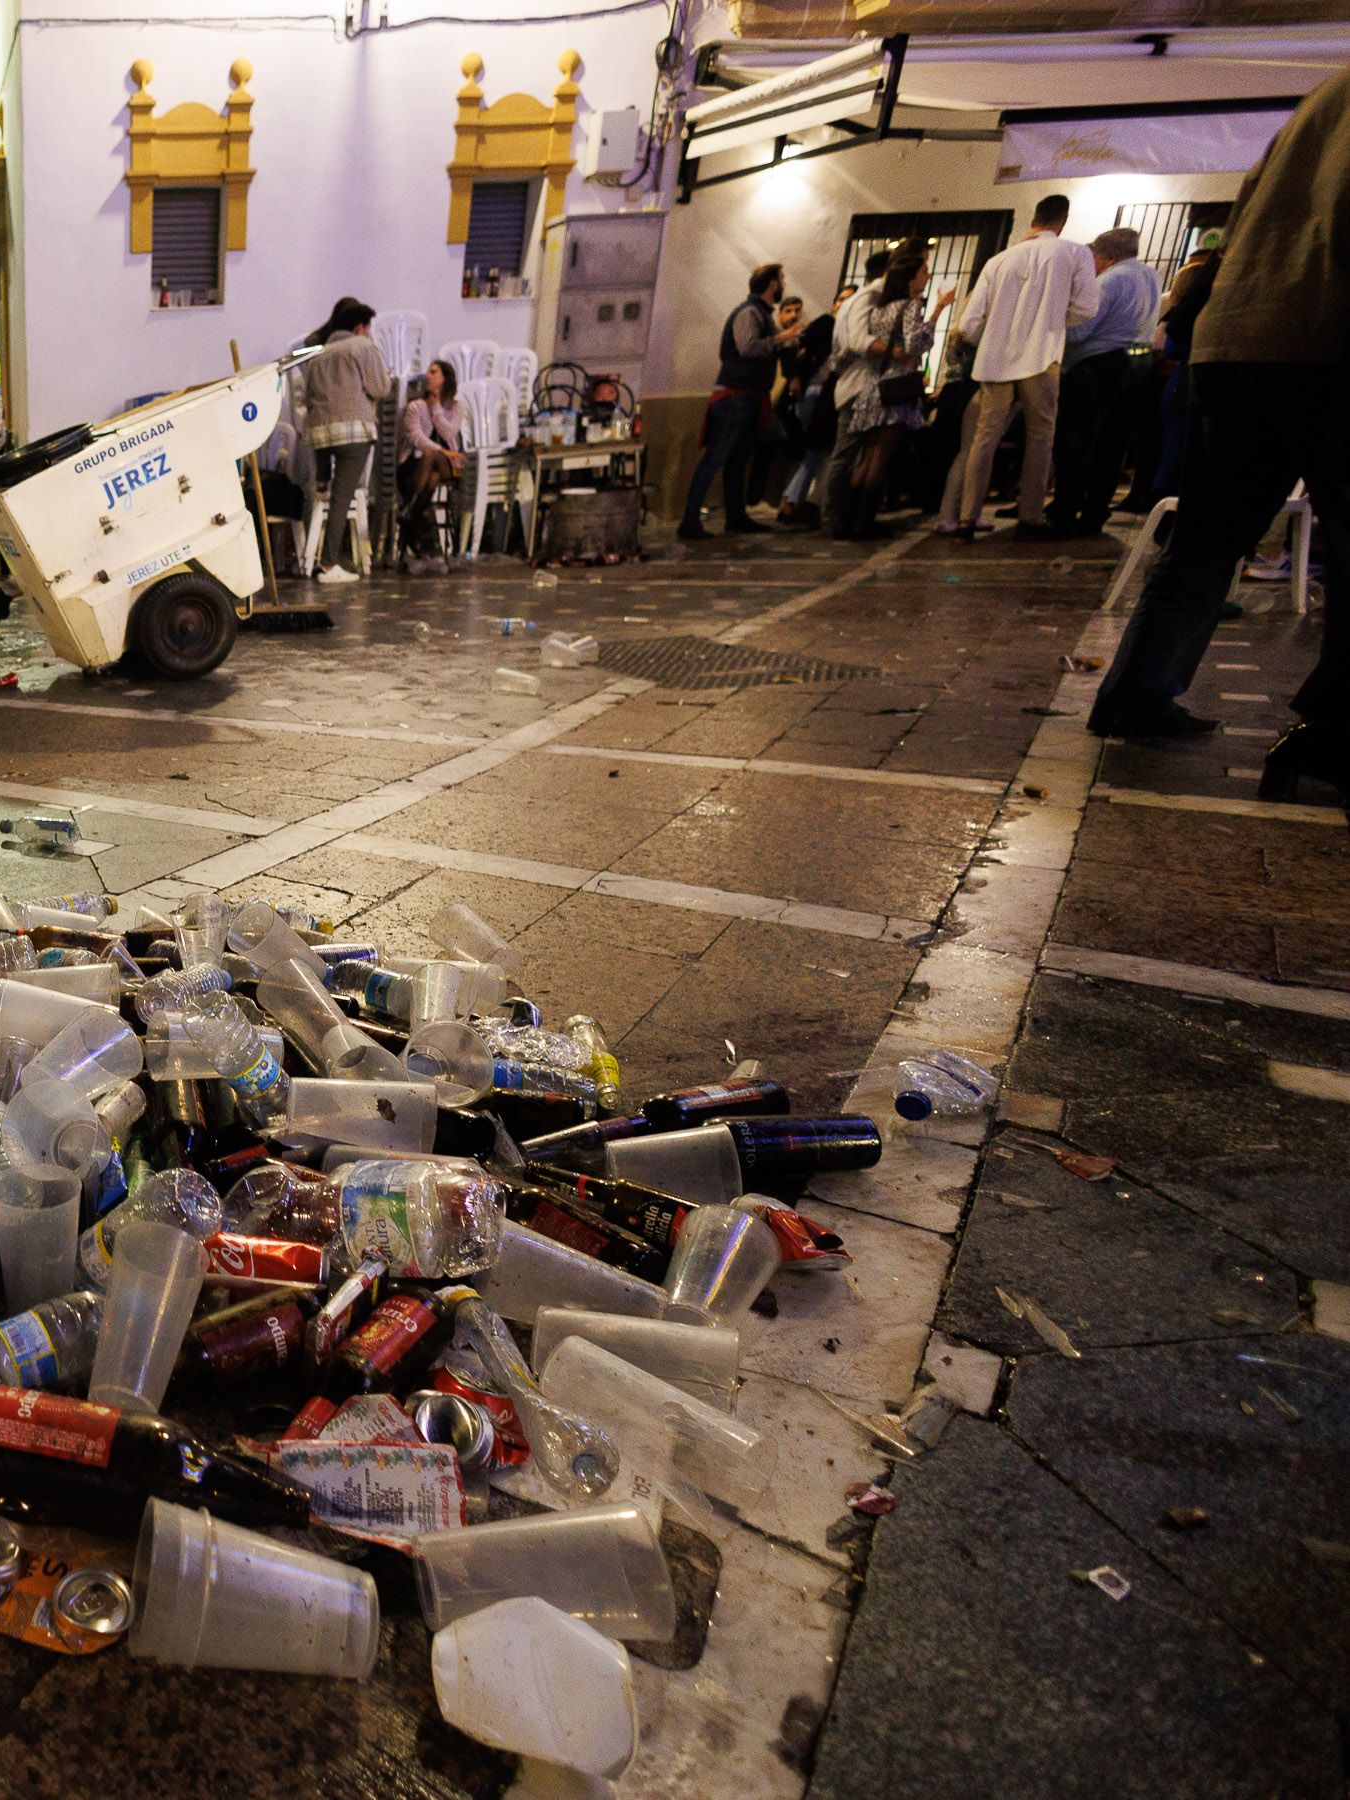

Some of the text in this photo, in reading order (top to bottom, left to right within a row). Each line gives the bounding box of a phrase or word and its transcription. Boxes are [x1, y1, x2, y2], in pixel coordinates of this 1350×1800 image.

[74, 446, 117, 474] GRUPO
[119, 420, 175, 453] BRIGADA
[102, 452, 172, 510] JEREZ
[126, 550, 183, 585] JEREZ UTE
